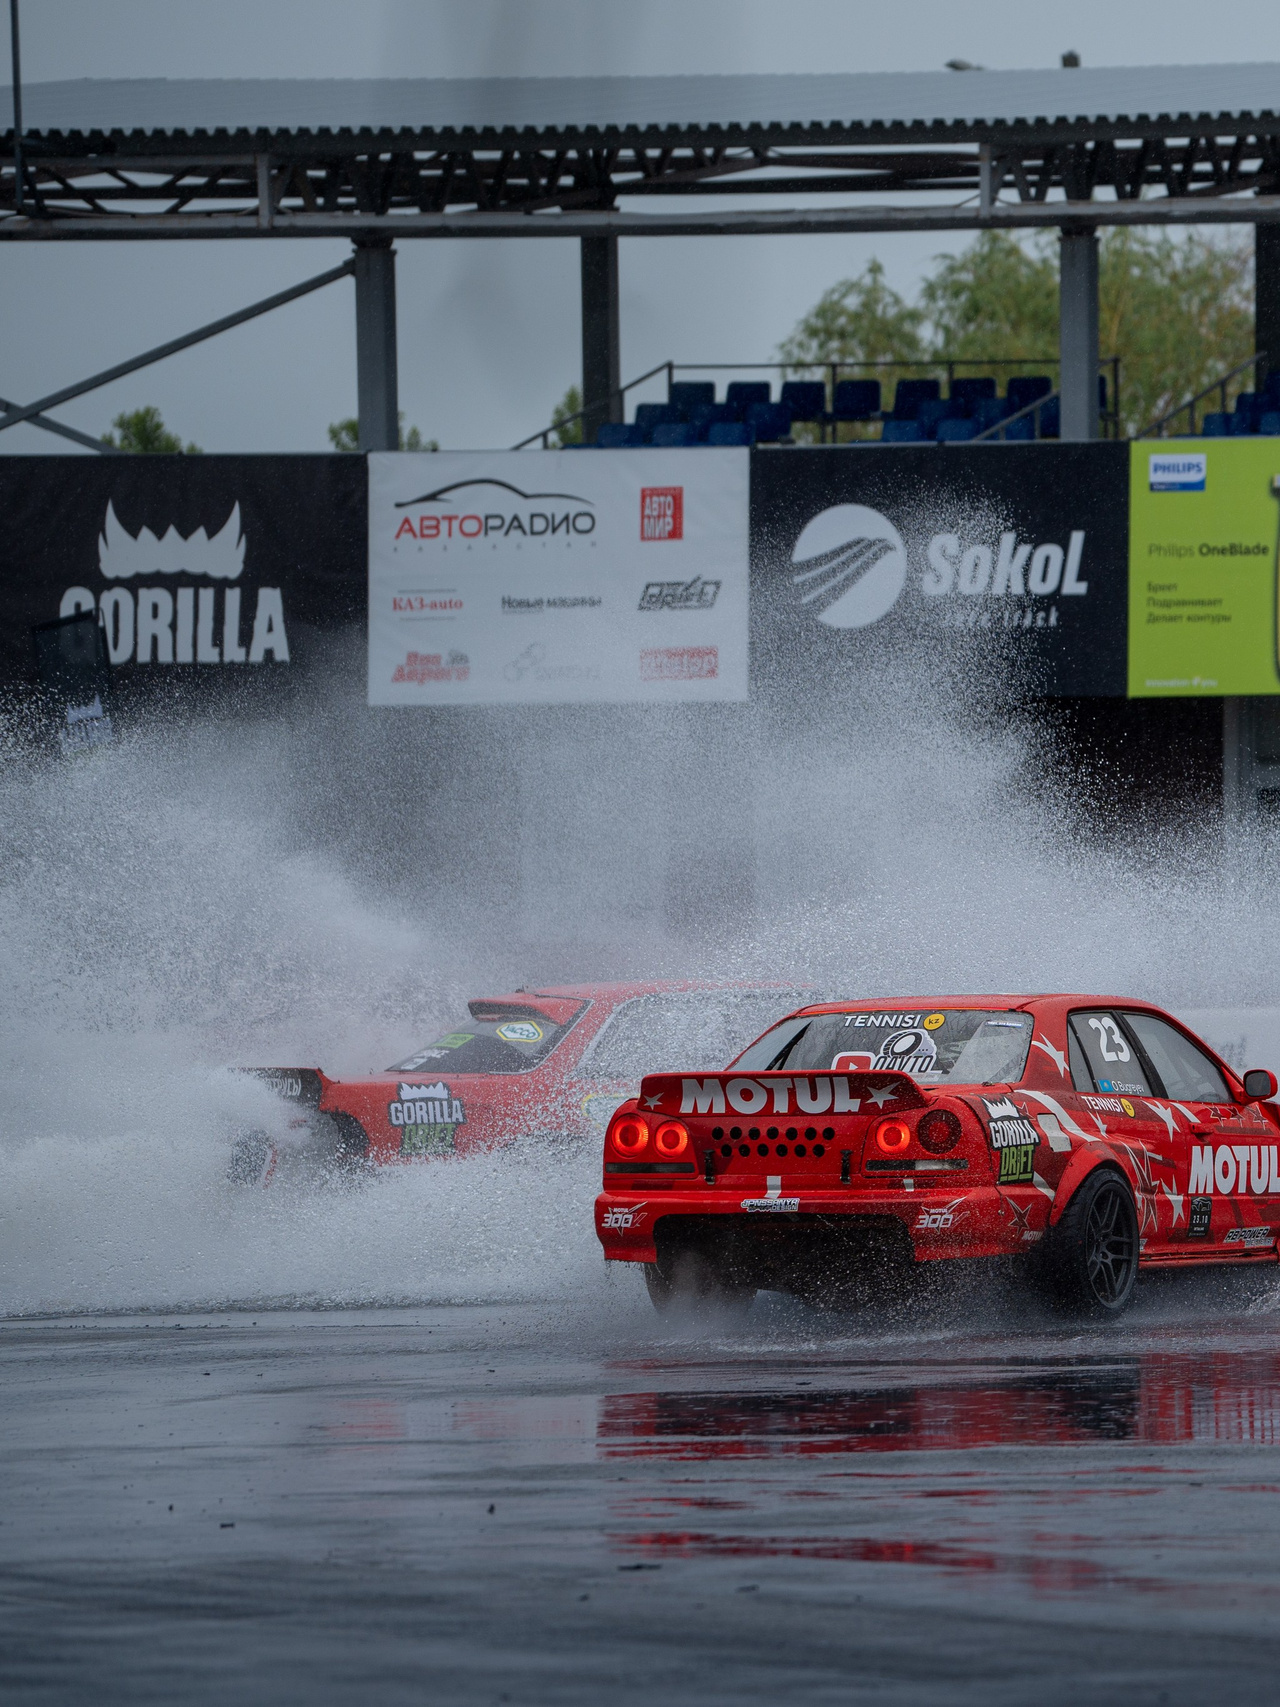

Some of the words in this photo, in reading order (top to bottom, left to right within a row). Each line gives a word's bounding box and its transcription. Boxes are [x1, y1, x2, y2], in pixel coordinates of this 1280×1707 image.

[1153, 462, 1203, 474] PHILIPS
[643, 495, 674, 516] АВТО
[394, 511, 596, 541] АВТОРАДИО
[643, 517, 674, 539] МИР
[1148, 543, 1195, 558] Philips
[1198, 542, 1270, 557] OneBlade
[844, 1014, 921, 1027] TENNISI
[504, 1024, 536, 1039] YACCO
[1088, 1016, 1131, 1063] 23
[679, 1076, 862, 1114] MOTUL
[1081, 1095, 1124, 1113] TENNISI
[390, 1100, 464, 1125] GORILLA
[989, 1119, 1039, 1148] GORILLA
[1022, 1231, 1044, 1240] MOTU
